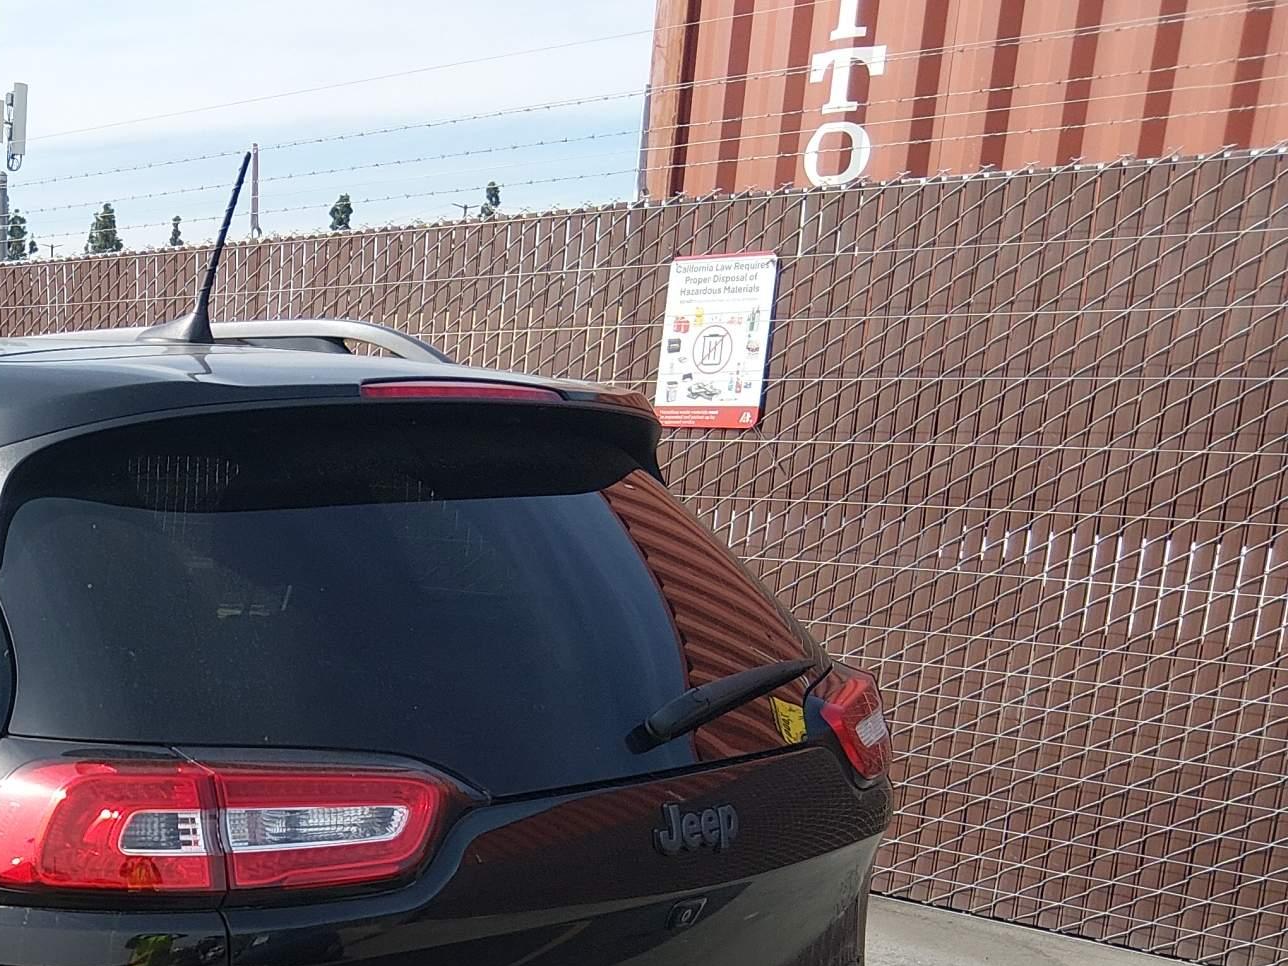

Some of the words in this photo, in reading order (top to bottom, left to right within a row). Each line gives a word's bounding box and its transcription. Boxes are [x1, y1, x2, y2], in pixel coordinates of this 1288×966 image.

[675, 263, 713, 274] California
[716, 263, 732, 272] Law
[734, 261, 770, 272] Requires
[684, 276, 712, 286] Proper
[713, 273, 748, 284] Disposal
[749, 272, 759, 281] of
[679, 286, 722, 297] Hazardous
[723, 284, 760, 294] Materials
[655, 802, 739, 853] Jeep
